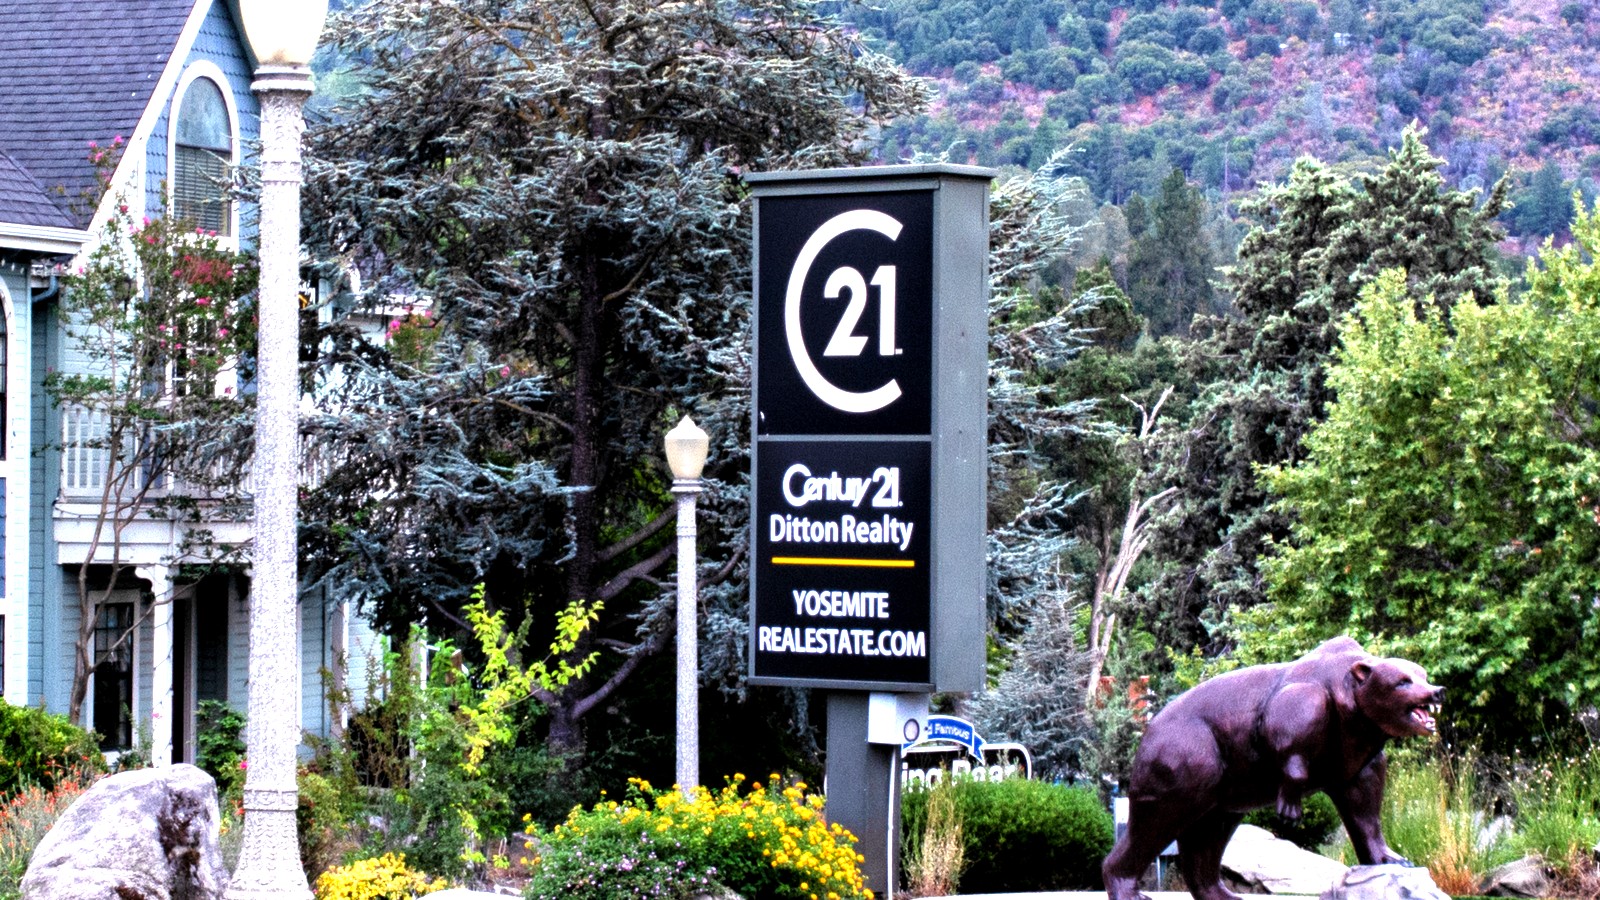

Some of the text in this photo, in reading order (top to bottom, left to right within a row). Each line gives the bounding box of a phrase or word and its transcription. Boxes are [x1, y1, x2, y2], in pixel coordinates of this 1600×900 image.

[782, 463, 872, 507] Century
[770, 513, 914, 551] Ditton Realty
[793, 590, 890, 618] YOSEMITE
[759, 626, 926, 657] REALESTATE.COM
[934, 723, 970, 740] Famous
